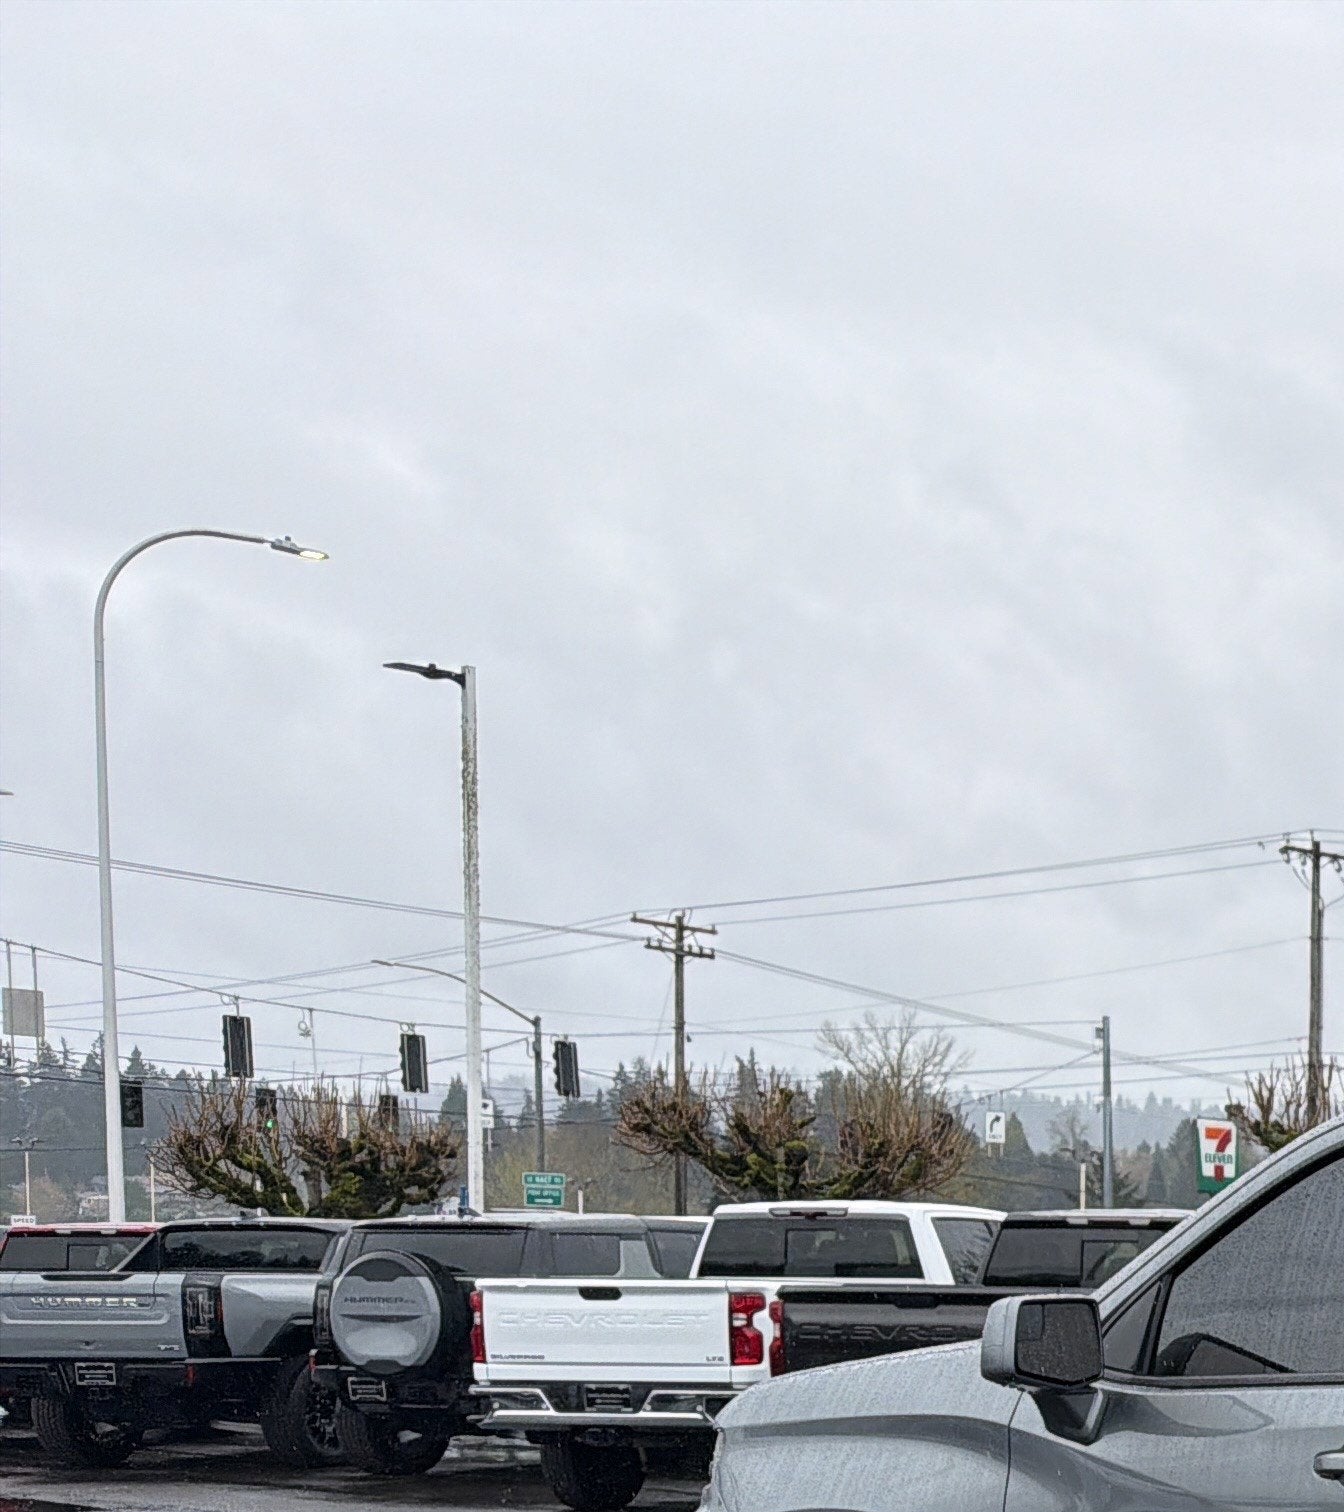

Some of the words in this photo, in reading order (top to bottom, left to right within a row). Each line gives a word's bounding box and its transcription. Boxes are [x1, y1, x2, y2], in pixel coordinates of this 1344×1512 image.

[1205, 1127, 1232, 1182] 7
[1205, 1153, 1233, 1164] ELEVEN
[798, 1325, 958, 1341] CHEVRO
